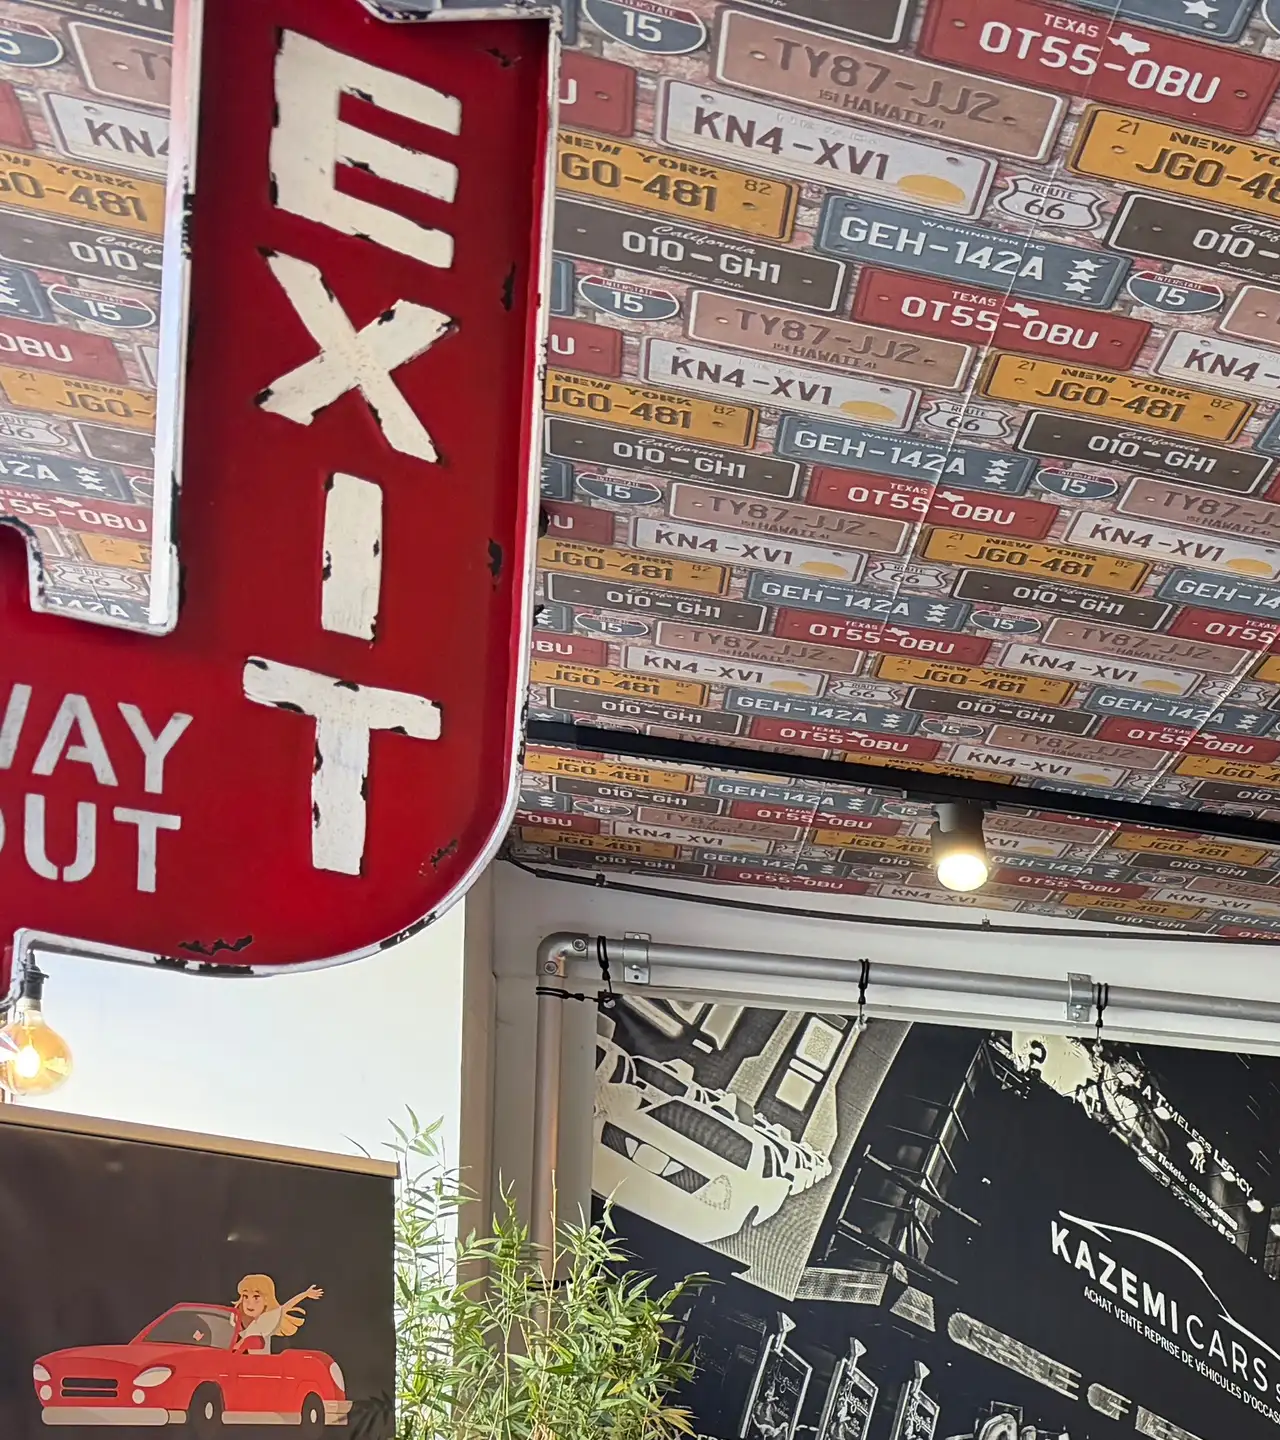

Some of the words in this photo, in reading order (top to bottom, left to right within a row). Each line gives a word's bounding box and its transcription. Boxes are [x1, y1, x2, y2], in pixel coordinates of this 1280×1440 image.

[1043, 13, 1102, 39] TEXAS
[692, 109, 889, 179] KN4-XV1
[1169, 131, 1237, 154] NEW
[1024, 198, 1068, 221] 66
[1030, 183, 1079, 200] ROUTE
[838, 215, 1043, 282] GEH-142A
[612, 291, 645, 311] 15
[1159, 285, 1191, 306] 15
[243, 28, 462, 876] EXIT
[792, 429, 965, 477] GEH-142A
[0, 793, 181, 893] UT
[1051, 1220, 1179, 1334] KAZEMI
[1186, 1314, 1268, 1392] CARS
[1084, 1286, 1112, 1314] ACHAT
[1114, 1308, 1143, 1335] VENTE
[1144, 1321, 1180, 1359] REPRISE
[1181, 1349, 1194, 1368] DE
[1194, 1359, 1241, 1400] VÉHICULES
